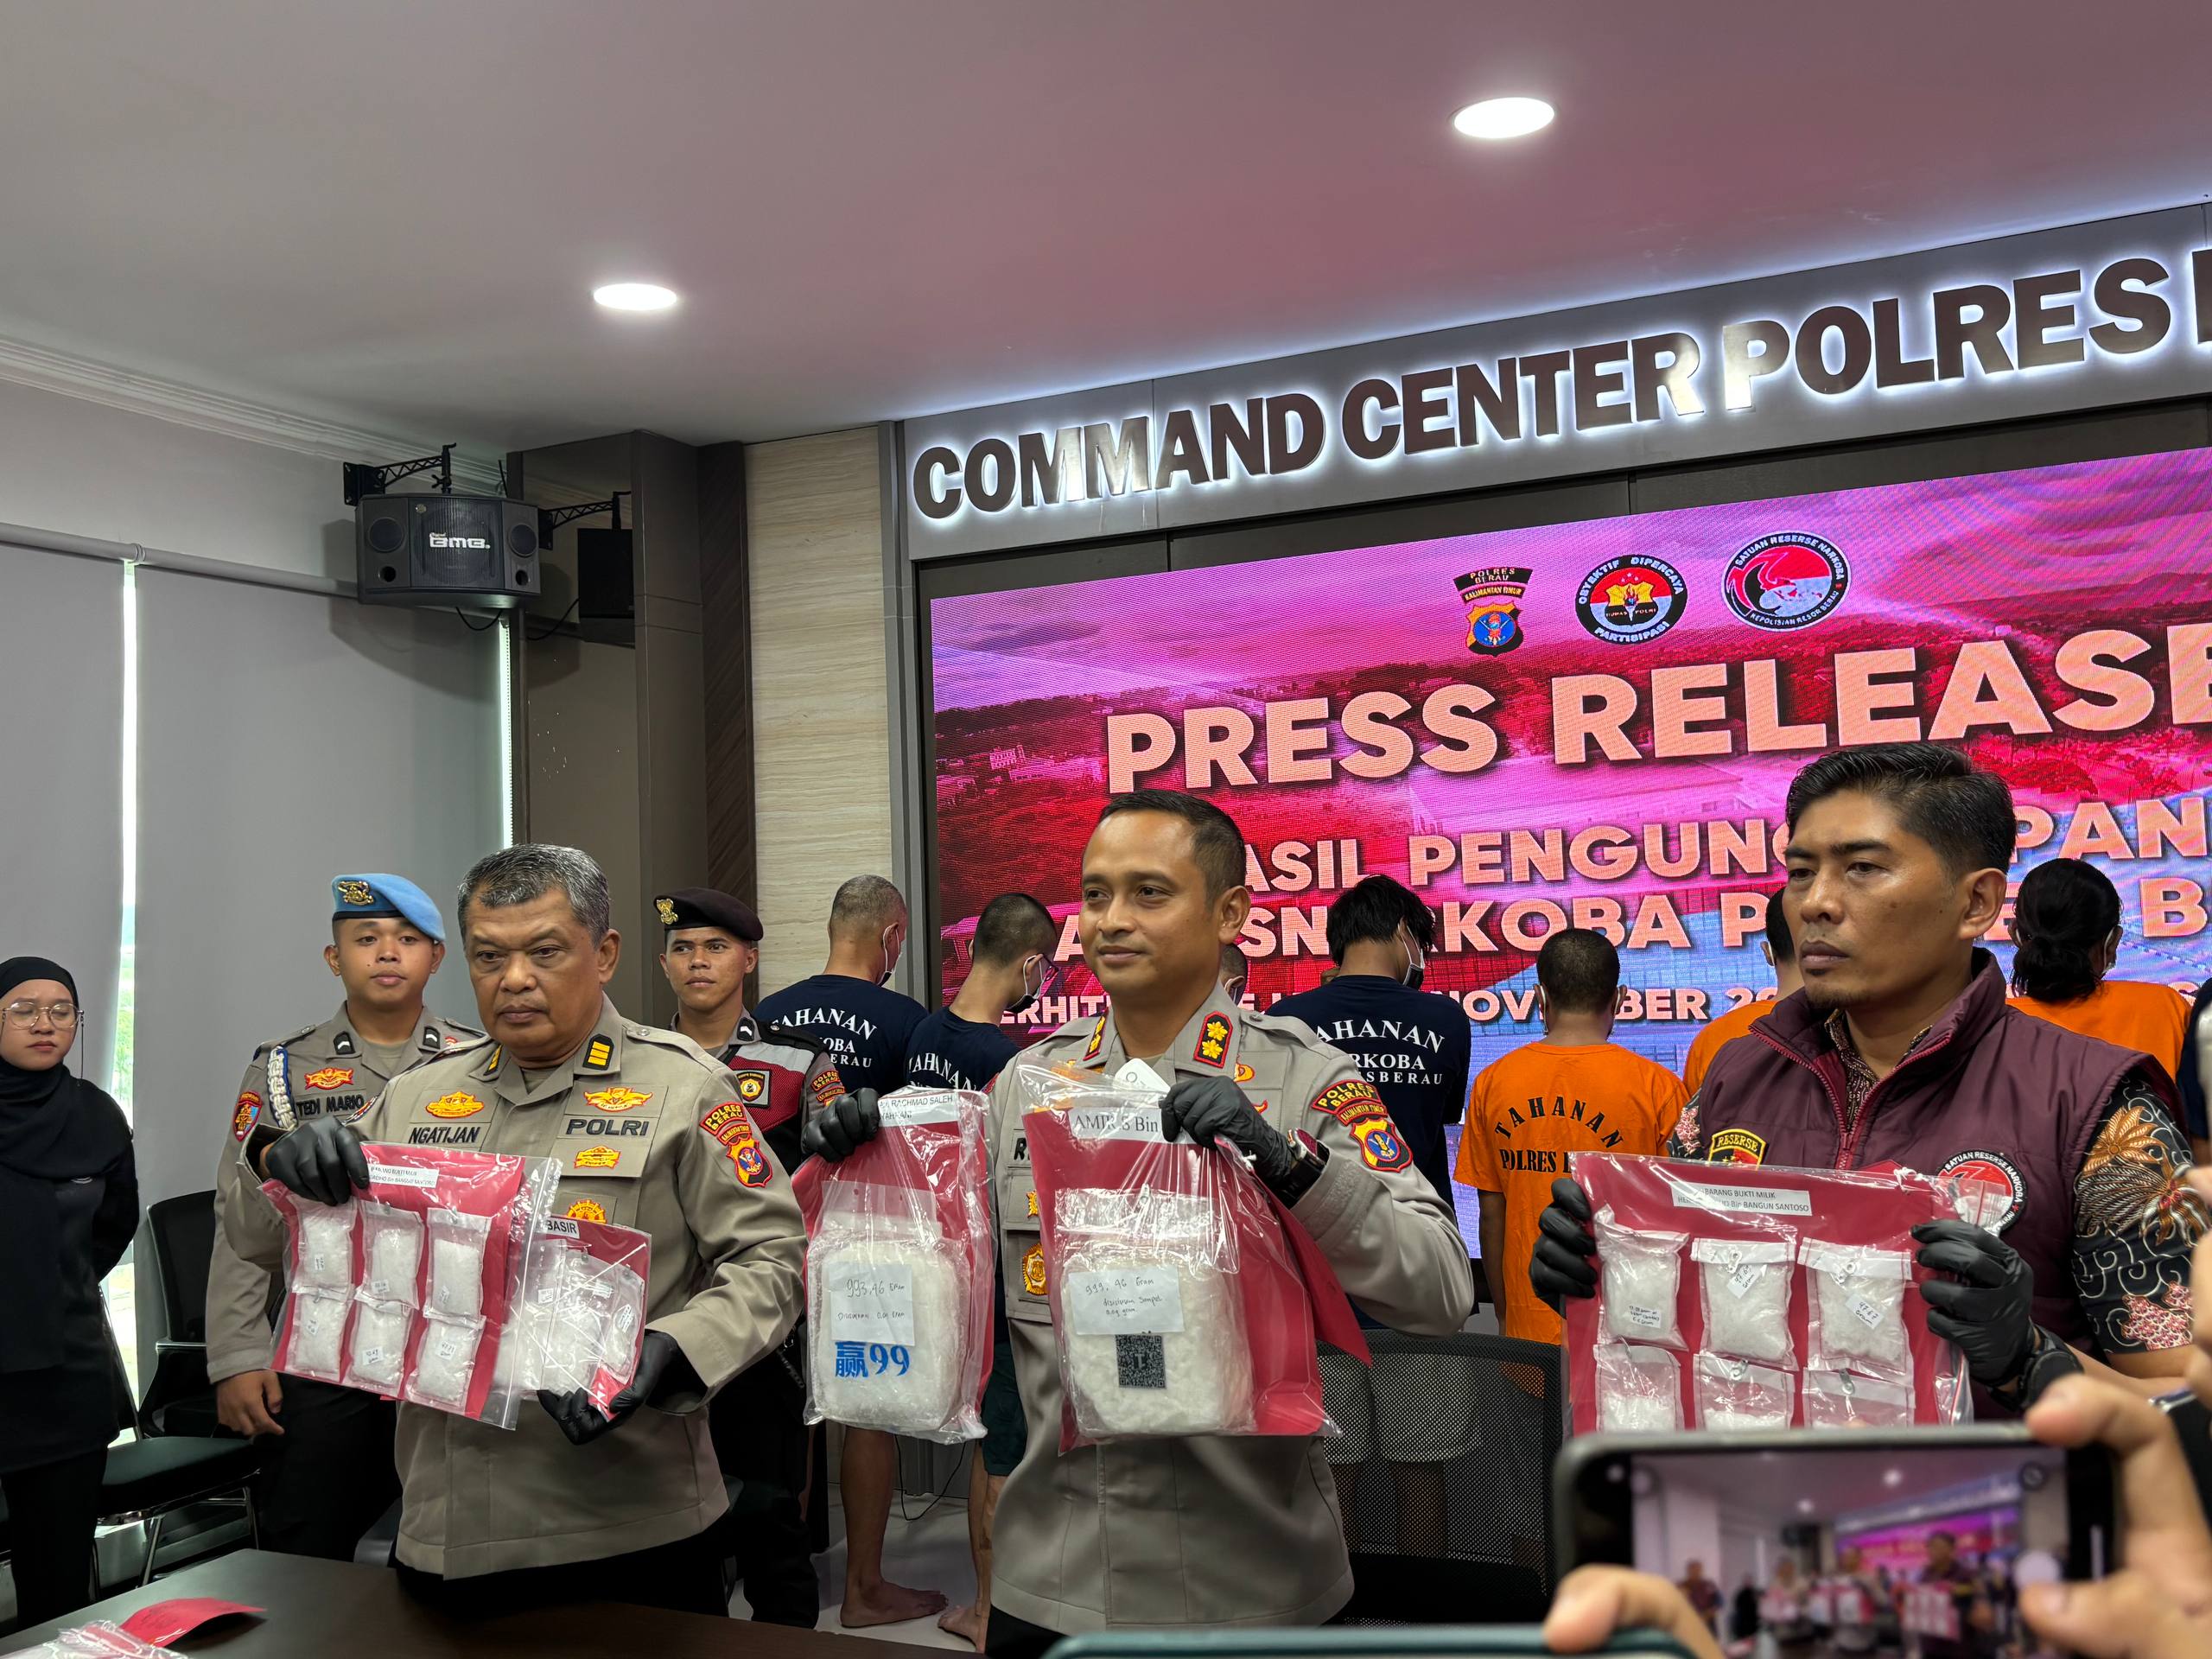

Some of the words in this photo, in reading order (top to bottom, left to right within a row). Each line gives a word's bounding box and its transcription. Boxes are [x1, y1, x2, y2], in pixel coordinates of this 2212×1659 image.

[912, 393, 1325, 519] COMMAND
[1342, 332, 1705, 460] CENTER
[1722, 257, 2171, 411] POLRES
[1817, 541, 1845, 581] NARKOBA
[1578, 559, 1620, 605] OBYEKTIF
[1630, 556, 1684, 594] DIPERCAYA
[1107, 683, 1497, 793] PRESS
[1245, 837, 1367, 892] ASIL
[772, 1007, 878, 1040] AHANAN
[1316, 1018, 1446, 1054] AHANAN
[1348, 1053, 1426, 1071] RKOBA
[929, 1095, 953, 1104] SALEH
[1318, 1082, 1375, 1107] POLRES
[1330, 1090, 1372, 1107] BERAU
[565, 1118, 650, 1136] POLRI
[705, 1104, 742, 1127] POLRES
[1135, 1116, 1159, 1133] Bin
[1494, 1096, 1624, 1148] TAHANAN
[408, 1126, 481, 1144] NGATIJAN
[1716, 1134, 1758, 1152] RESERSE
[1944, 1151, 1974, 1171] SATUAN
[1974, 1151, 2009, 1169] RESERSE
[2005, 1166, 2024, 1203] NARKOBA
[1704, 1188, 1734, 1197] BARANG
[1734, 1190, 1755, 1198] BUKTI
[1775, 1203, 1809, 1211] SANTOSO
